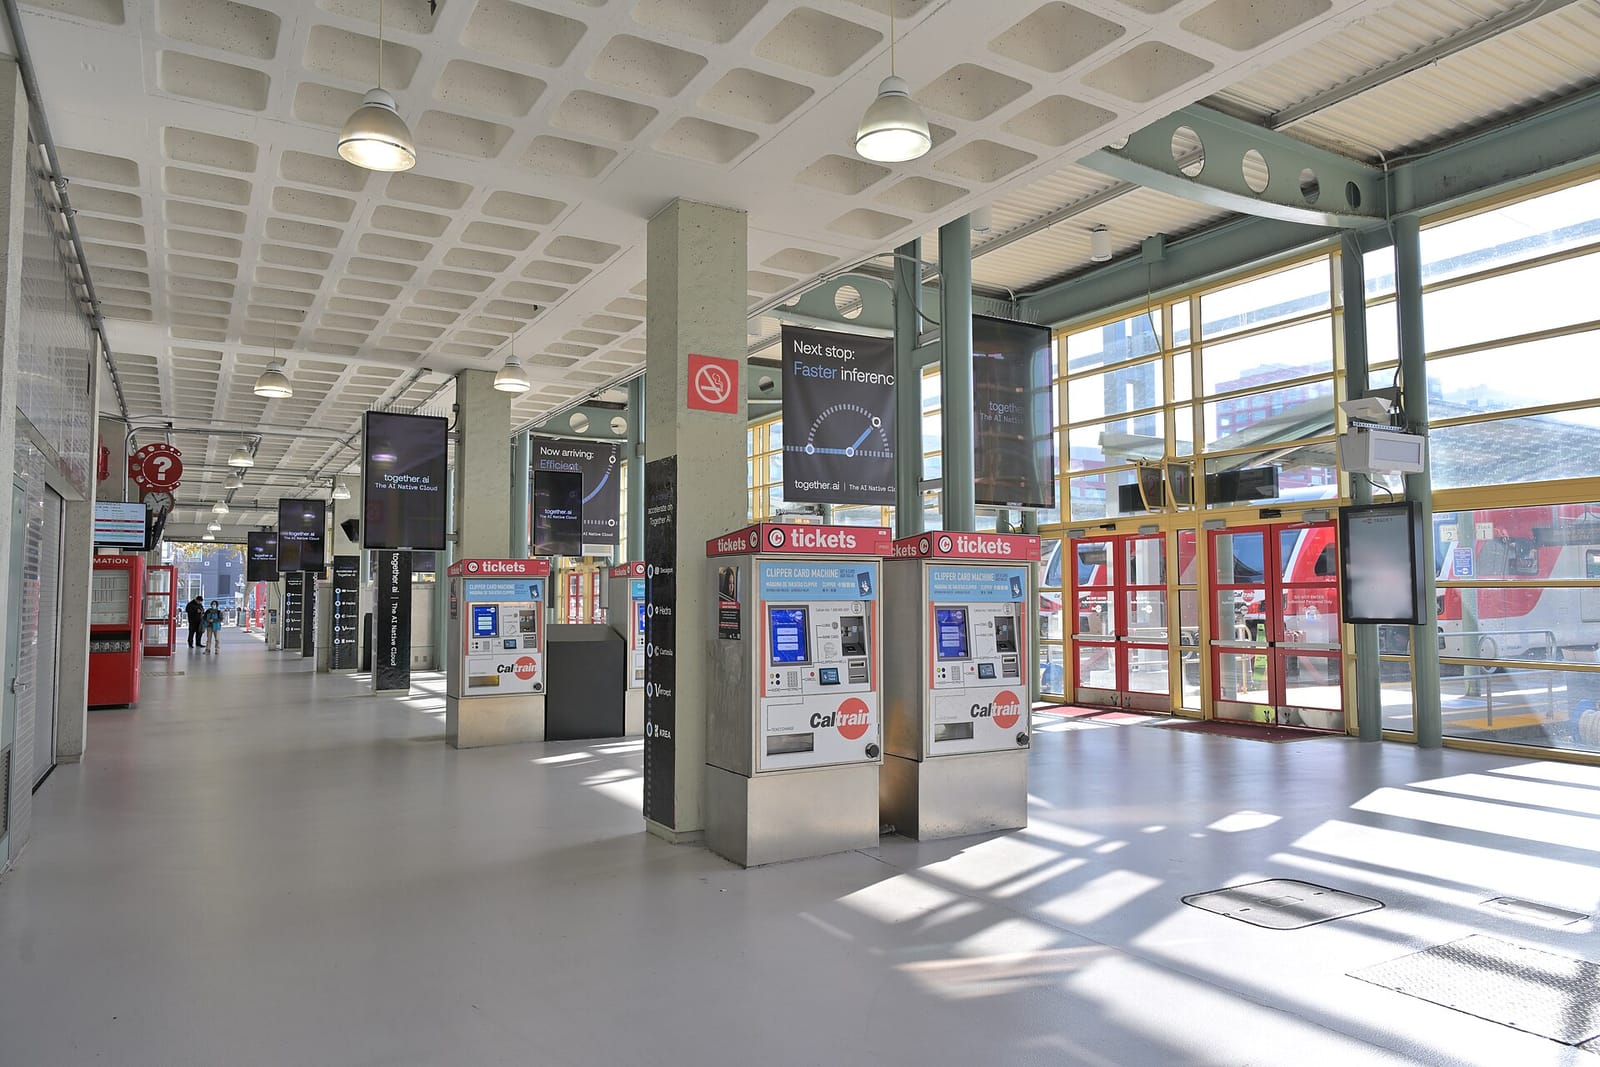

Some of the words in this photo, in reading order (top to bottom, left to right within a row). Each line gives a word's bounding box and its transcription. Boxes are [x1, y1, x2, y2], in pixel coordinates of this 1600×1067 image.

[794, 340, 822, 356] Next
[825, 346, 856, 362] stop:
[794, 361, 838, 380] Faster
[841, 366, 894, 386] inferenc
[540, 447, 560, 456] Now
[562, 449, 594, 460] arriving:
[384, 474, 430, 484] together.ai
[795, 480, 840, 492] together.ai
[648, 505, 666, 514] accelerate
[649, 517, 666, 527] Together
[791, 528, 856, 549] tickets
[718, 538, 746, 552] tickets
[957, 536, 1011, 554] tickets
[391, 553, 399, 593] together.ai
[482, 562, 526, 572] tickets
[766, 568, 793, 578] CLIPPER
[794, 568, 810, 578] CARD
[812, 569, 838, 578] MACHINE
[660, 606, 671, 616] Hedra
[497, 662, 537, 673] Caltrain
[970, 701, 1020, 718] Caltrain
[810, 709, 870, 728] Caltrain
[660, 728, 671, 739] KREA
